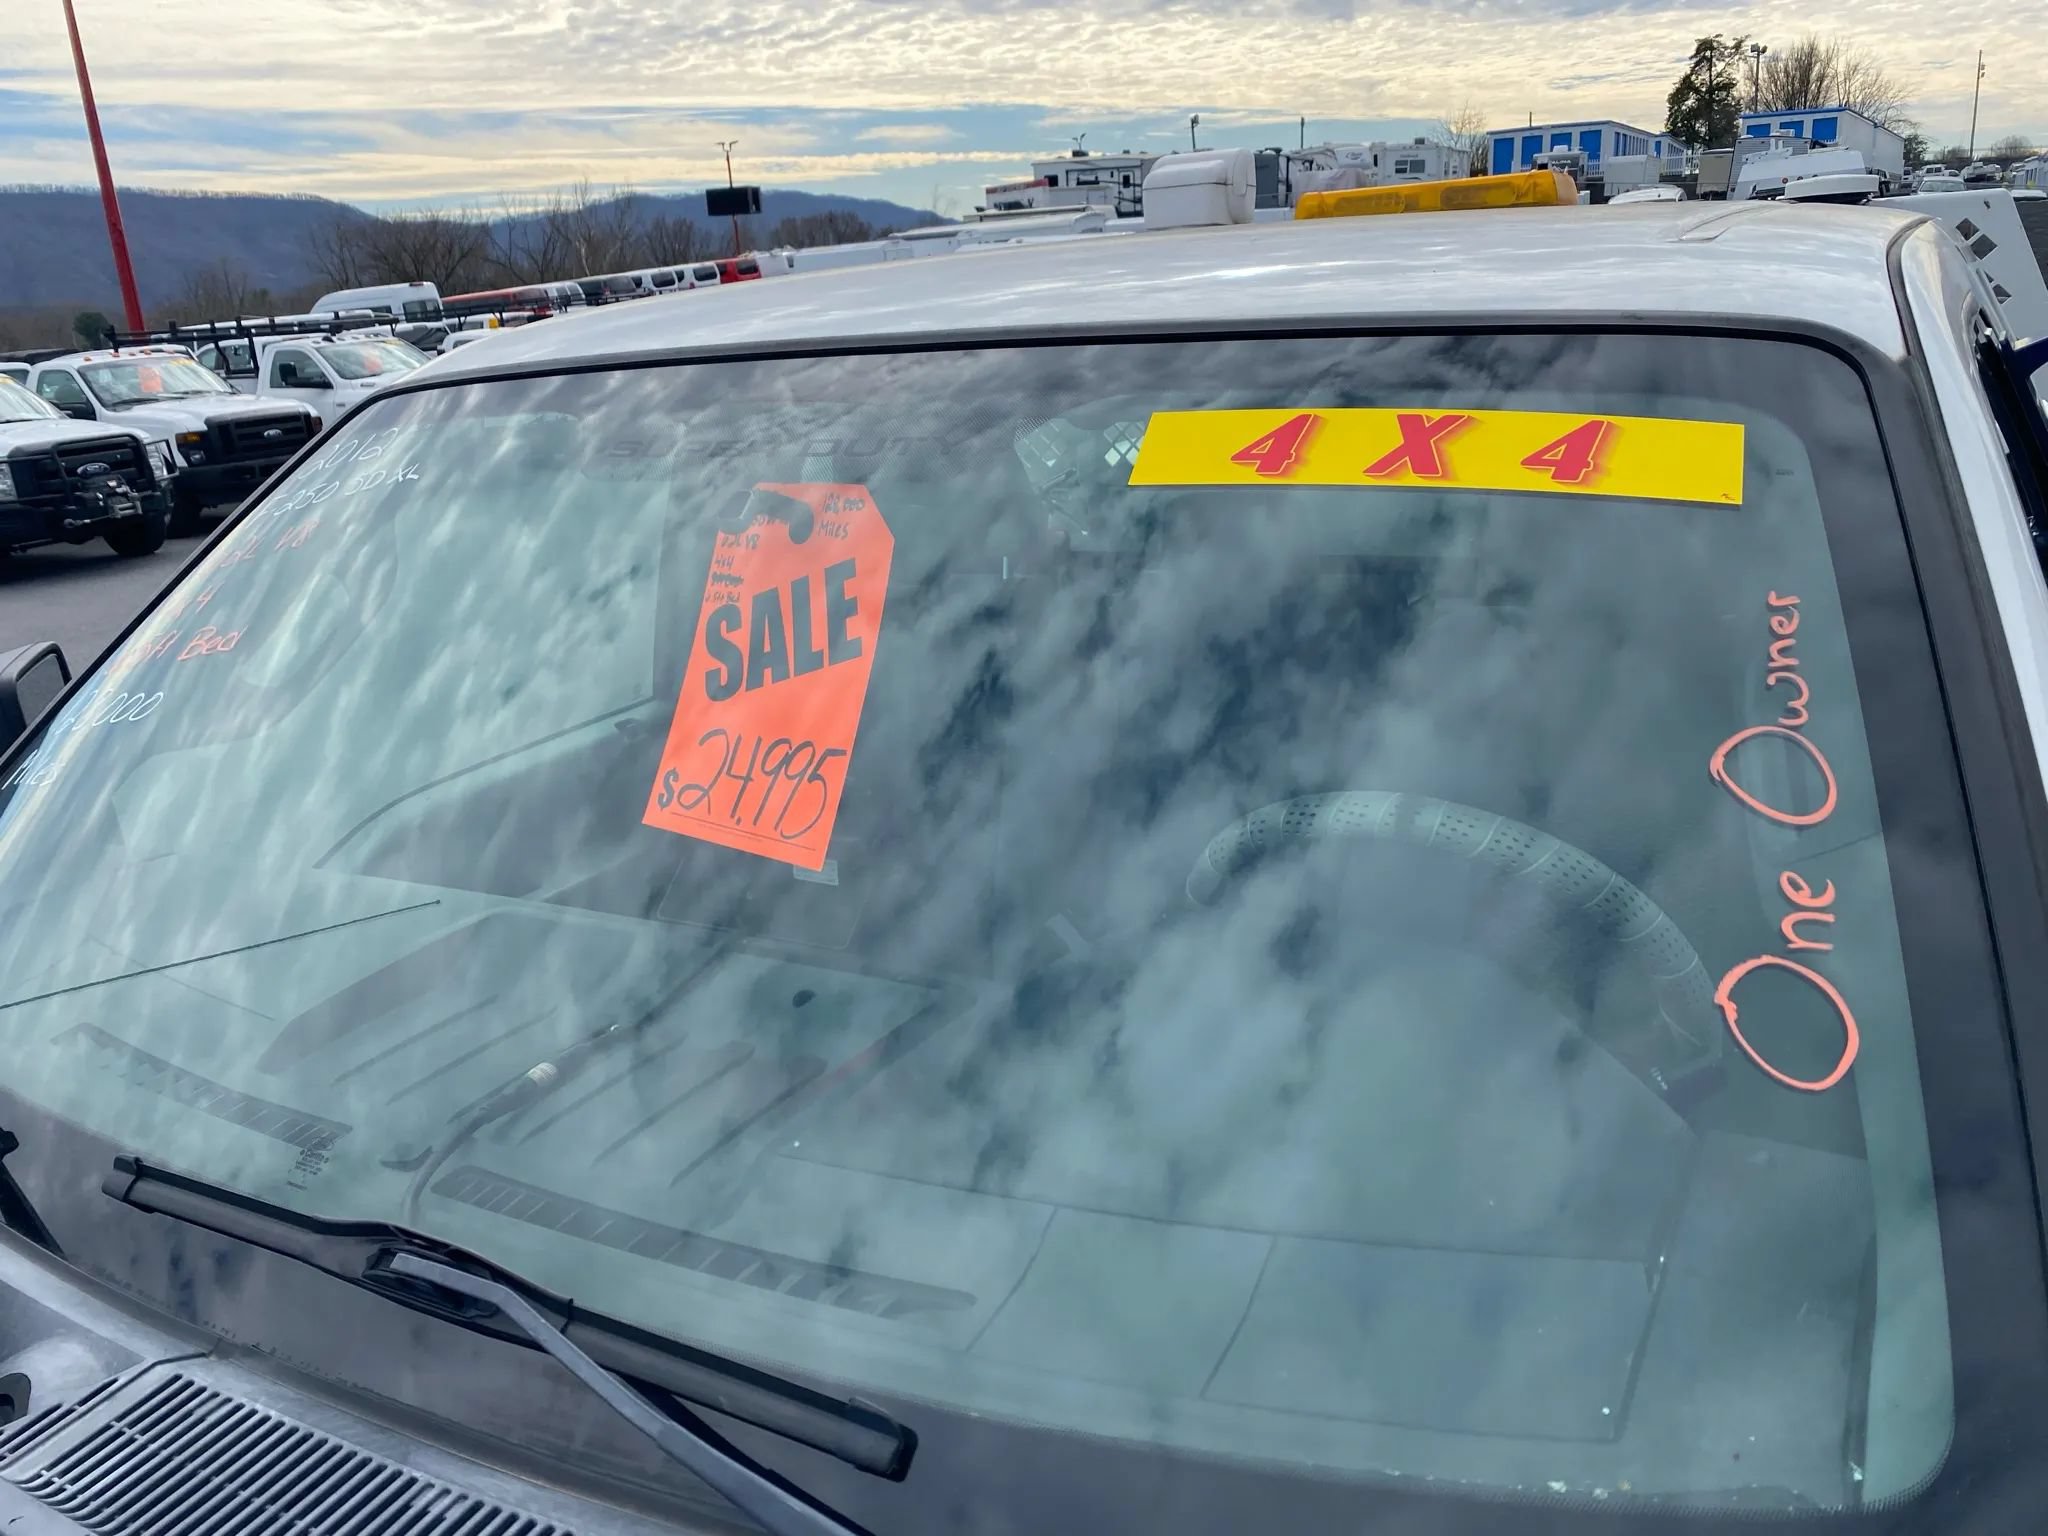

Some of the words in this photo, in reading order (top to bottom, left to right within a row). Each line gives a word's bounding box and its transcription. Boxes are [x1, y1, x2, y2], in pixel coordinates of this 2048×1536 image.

[297, 427, 400, 480] 2012
[1230, 413, 1316, 475] 4
[1362, 413, 1469, 477] X
[1520, 419, 1609, 483] 4
[177, 625, 248, 662] Bed
[705, 557, 863, 702] SALE
[1709, 590, 1838, 826] Owner
[1713, 870, 1860, 1092] One
